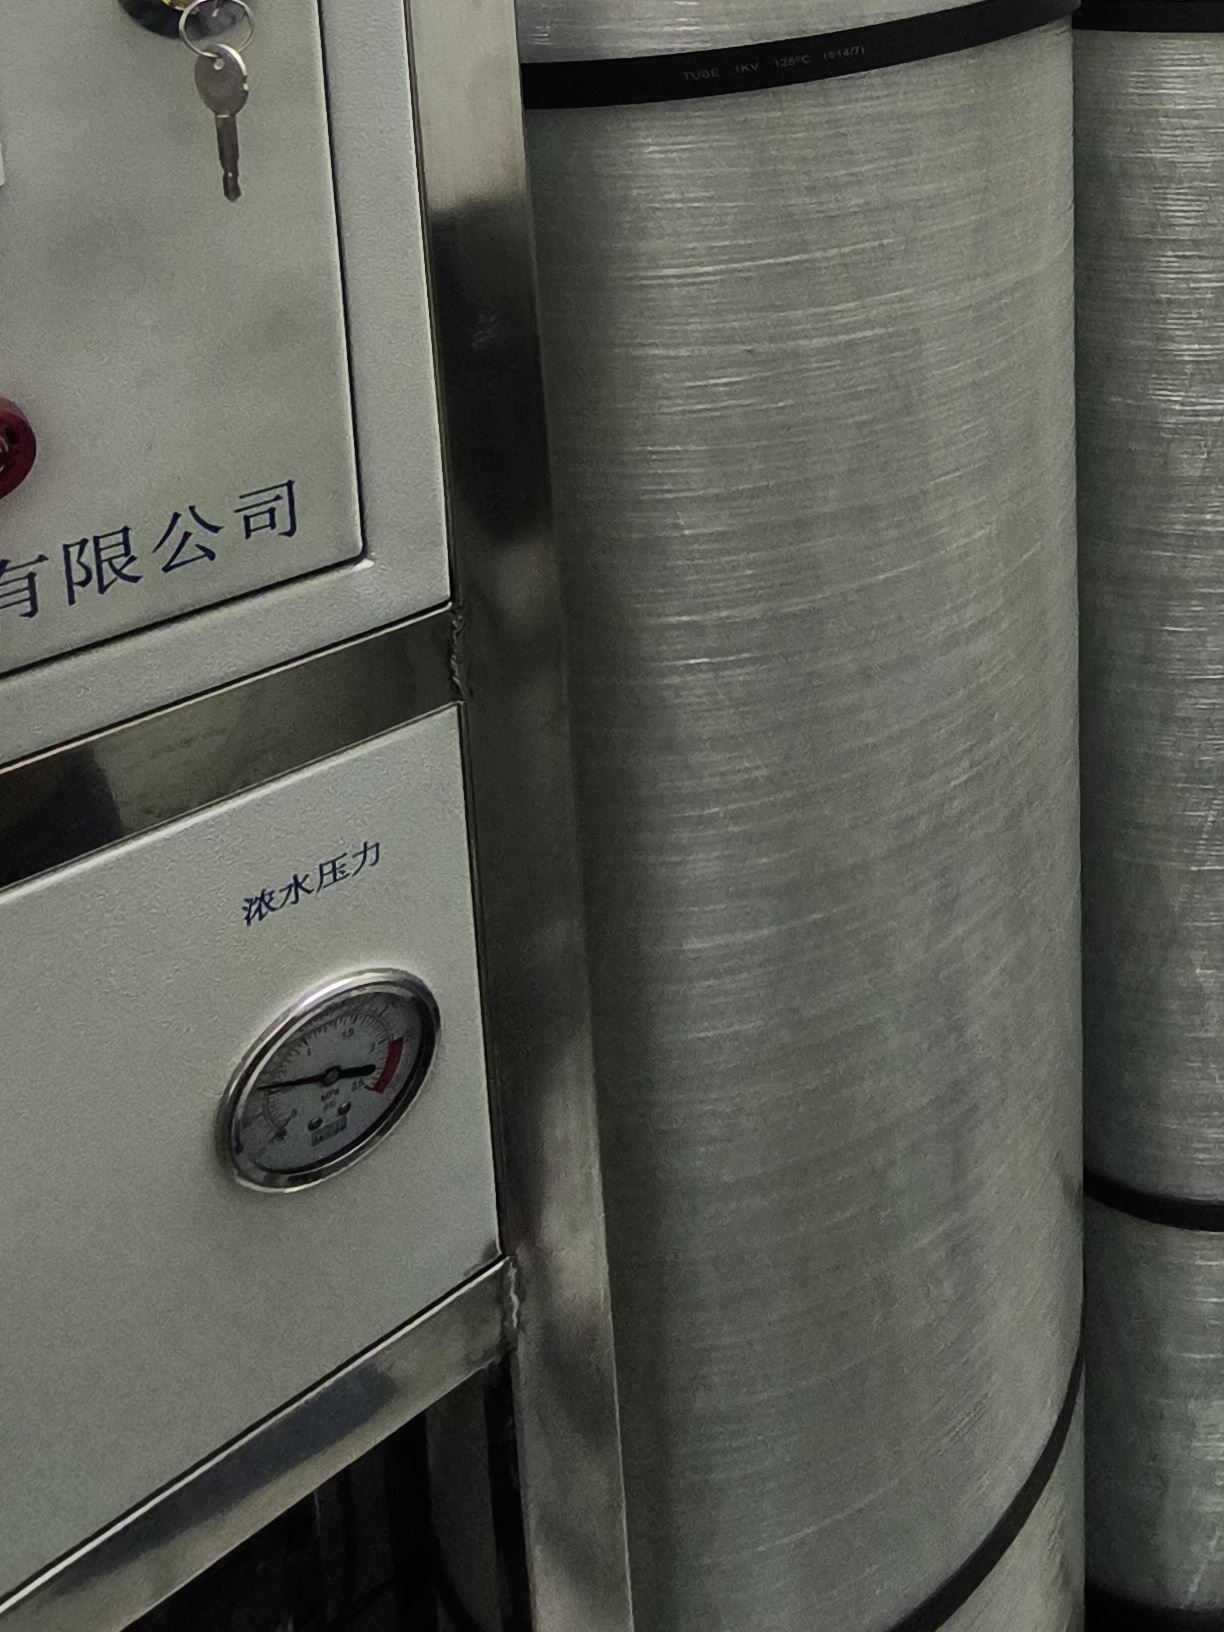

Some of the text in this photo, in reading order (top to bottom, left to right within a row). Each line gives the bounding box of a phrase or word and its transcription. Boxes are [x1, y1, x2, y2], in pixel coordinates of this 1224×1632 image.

[682, 68, 720, 81] TUBE
[0, 479, 299, 618] 有限公司
[241, 840, 382, 927] 浓水压力
